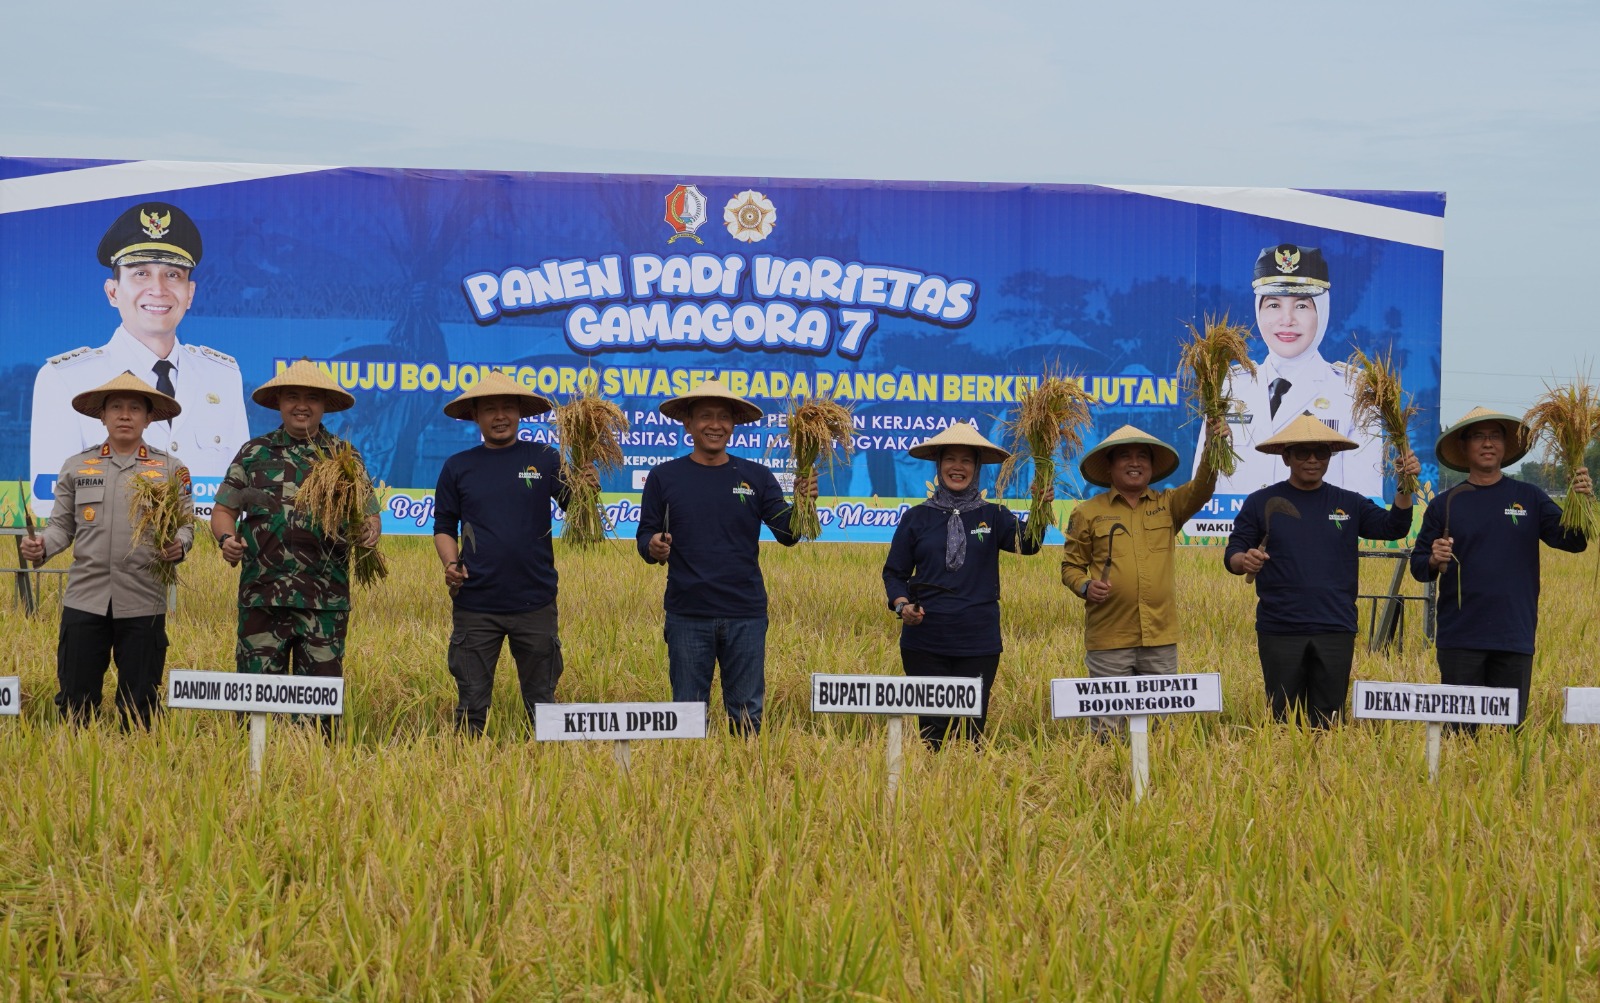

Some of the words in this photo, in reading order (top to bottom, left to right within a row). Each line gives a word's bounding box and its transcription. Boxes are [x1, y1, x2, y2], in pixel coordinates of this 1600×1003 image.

[466, 257, 622, 317] PANEN
[569, 303, 829, 347] GAMAGORA
[841, 310, 873, 352] 7
[276, 360, 395, 389] NUJU
[816, 372, 938, 401] PANGAN
[77, 478, 104, 487] AFRIAN
[1196, 523, 1235, 532] WAKIL
[173, 679, 221, 700] DANDIM
[223, 682, 252, 702] 0813
[255, 684, 338, 706] BOJONEGORO
[818, 681, 872, 706] BUPATI
[875, 683, 977, 709] BOJONEGORO
[1074, 680, 1132, 696] WAKIL
[1136, 678, 1198, 693] BUPATI
[1079, 695, 1195, 713] BOJONEGORO
[1364, 690, 1411, 713] DEKAN
[1415, 693, 1476, 715] FAPERTA
[1480, 696, 1511, 717] UGM
[563, 712, 620, 733] KETUA
[626, 710, 678, 732] DPRD
